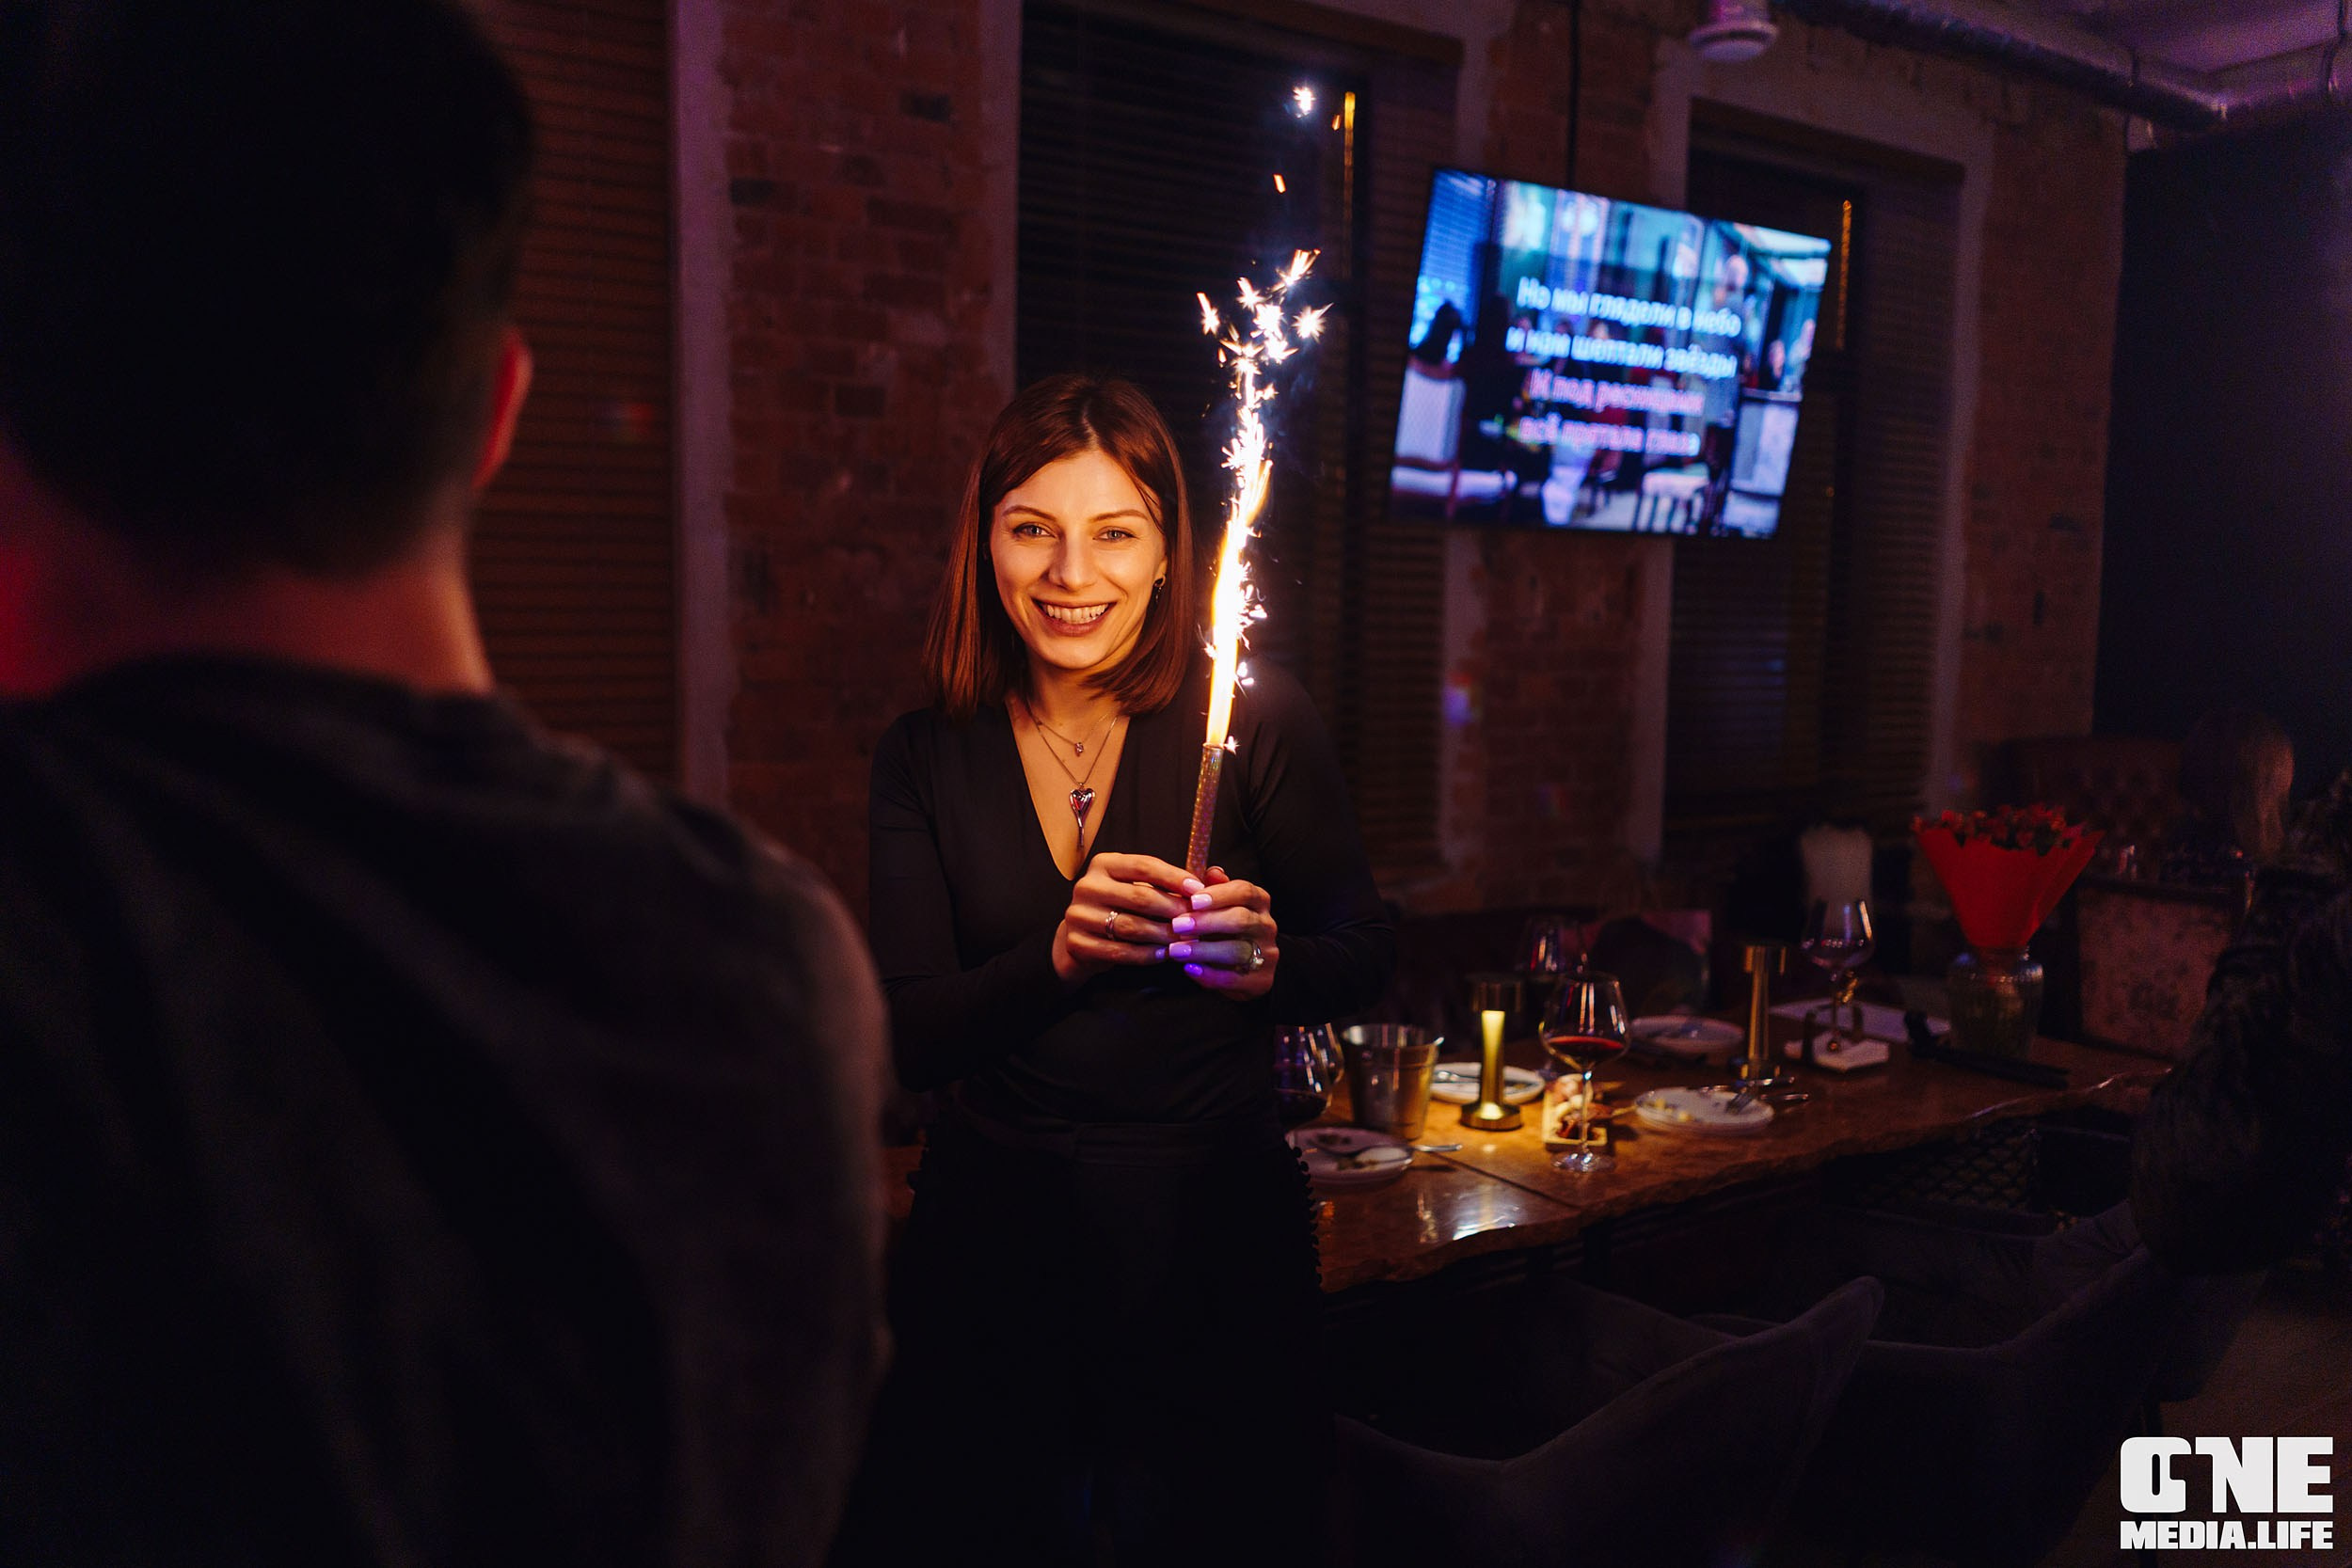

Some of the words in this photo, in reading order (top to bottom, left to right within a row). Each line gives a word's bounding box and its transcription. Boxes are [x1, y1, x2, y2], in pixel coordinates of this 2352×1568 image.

[1517, 276, 1550, 310] Но
[1552, 287, 1589, 315] мы
[1589, 293, 1677, 327] глядели
[1677, 306, 1692, 330] в
[1693, 308, 1741, 337] небо
[1525, 329, 1570, 358] нам
[1570, 335, 1664, 370] шептали
[1664, 343, 1738, 380] звёзды
